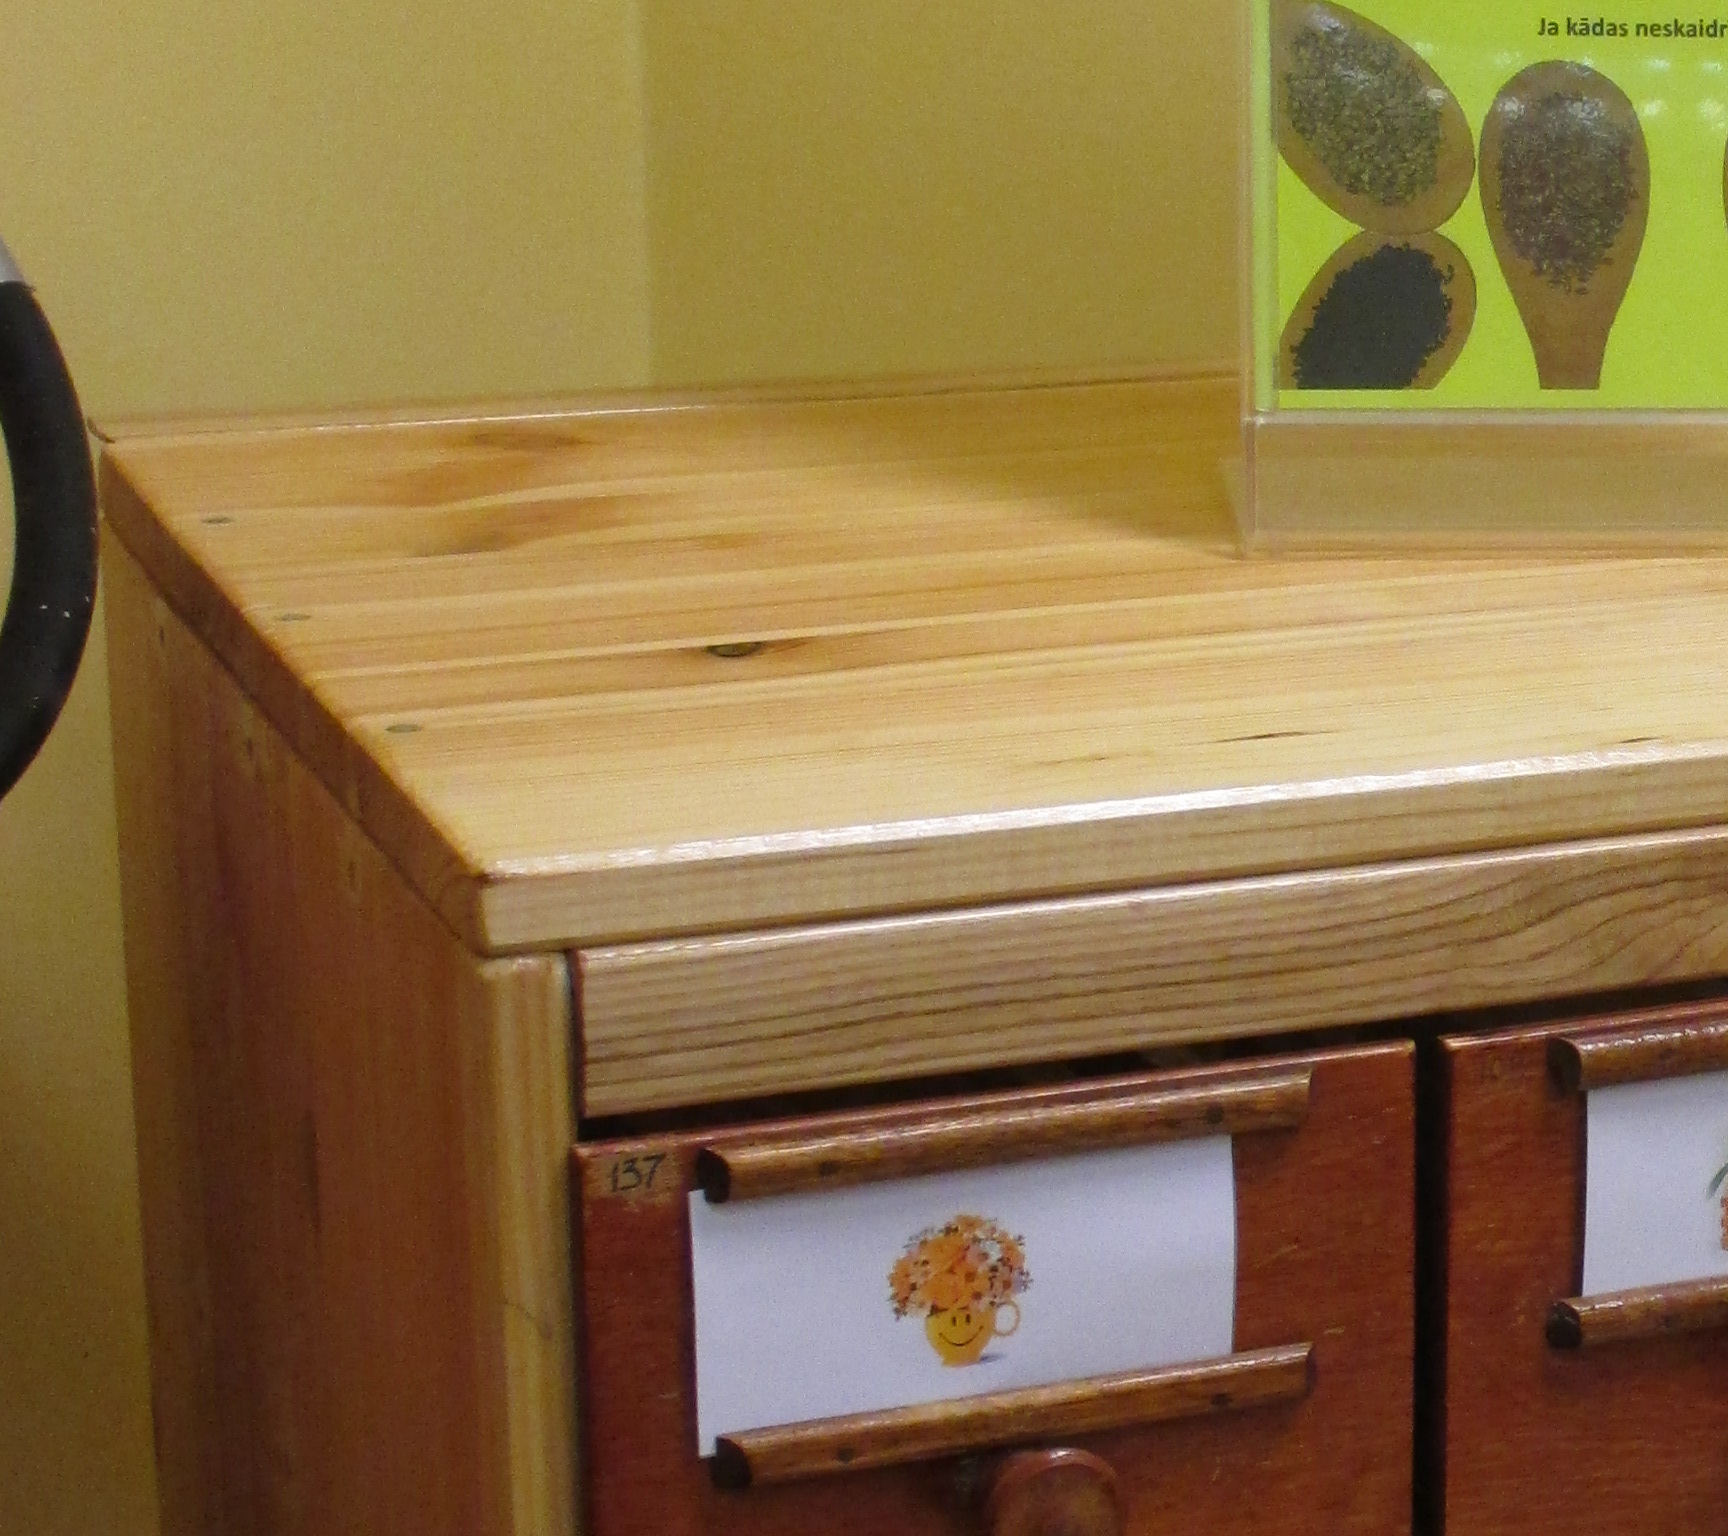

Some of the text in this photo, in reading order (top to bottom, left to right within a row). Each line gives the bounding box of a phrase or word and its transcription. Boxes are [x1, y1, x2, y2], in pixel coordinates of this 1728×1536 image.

[1537, 17, 1560, 37] Ja
[1566, 16, 1629, 38] kādas
[609, 1151, 667, 1194] 137
